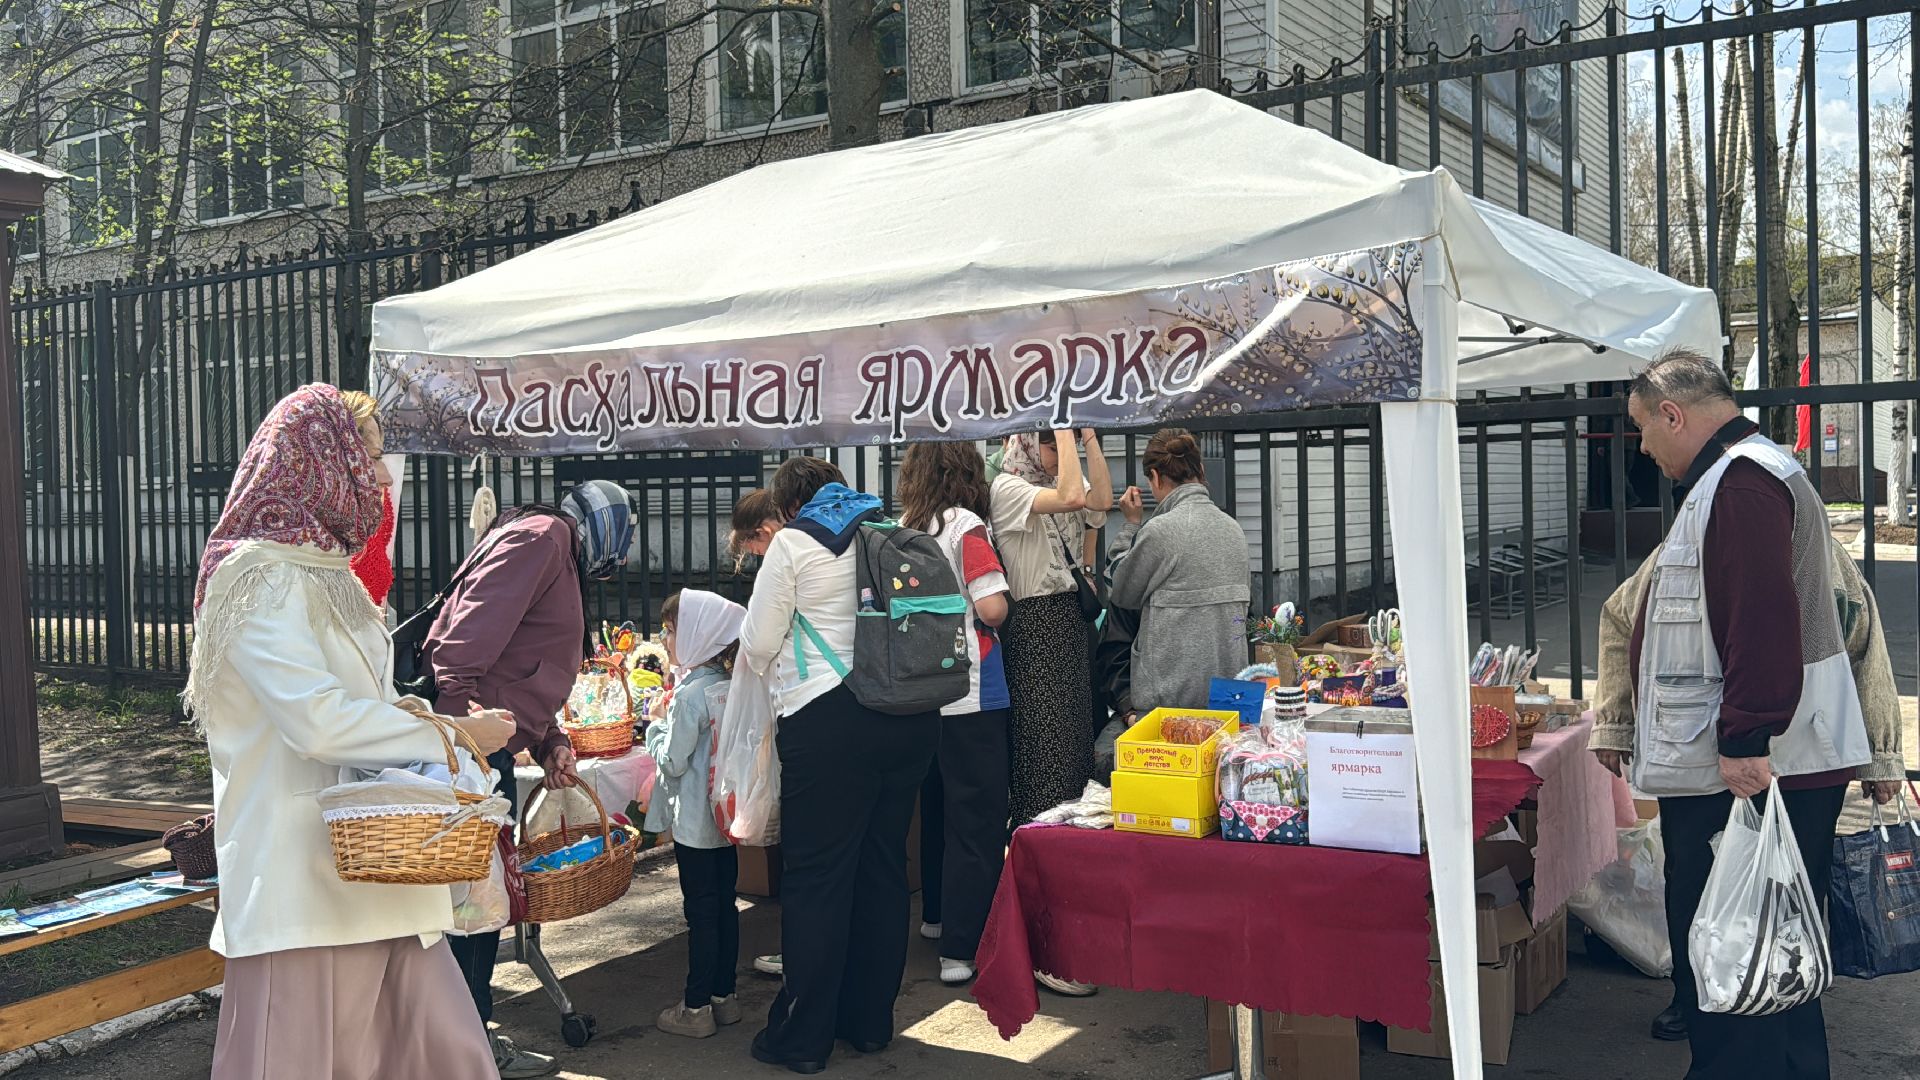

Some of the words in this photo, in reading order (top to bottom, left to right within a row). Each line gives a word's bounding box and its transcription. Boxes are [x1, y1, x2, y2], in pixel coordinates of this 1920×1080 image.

[468, 355, 824, 450] Пасхальная
[852, 325, 1209, 441] ярмарка
[1330, 746, 1403, 757] Благотворительная
[1331, 763, 1382, 776] ярмарка
